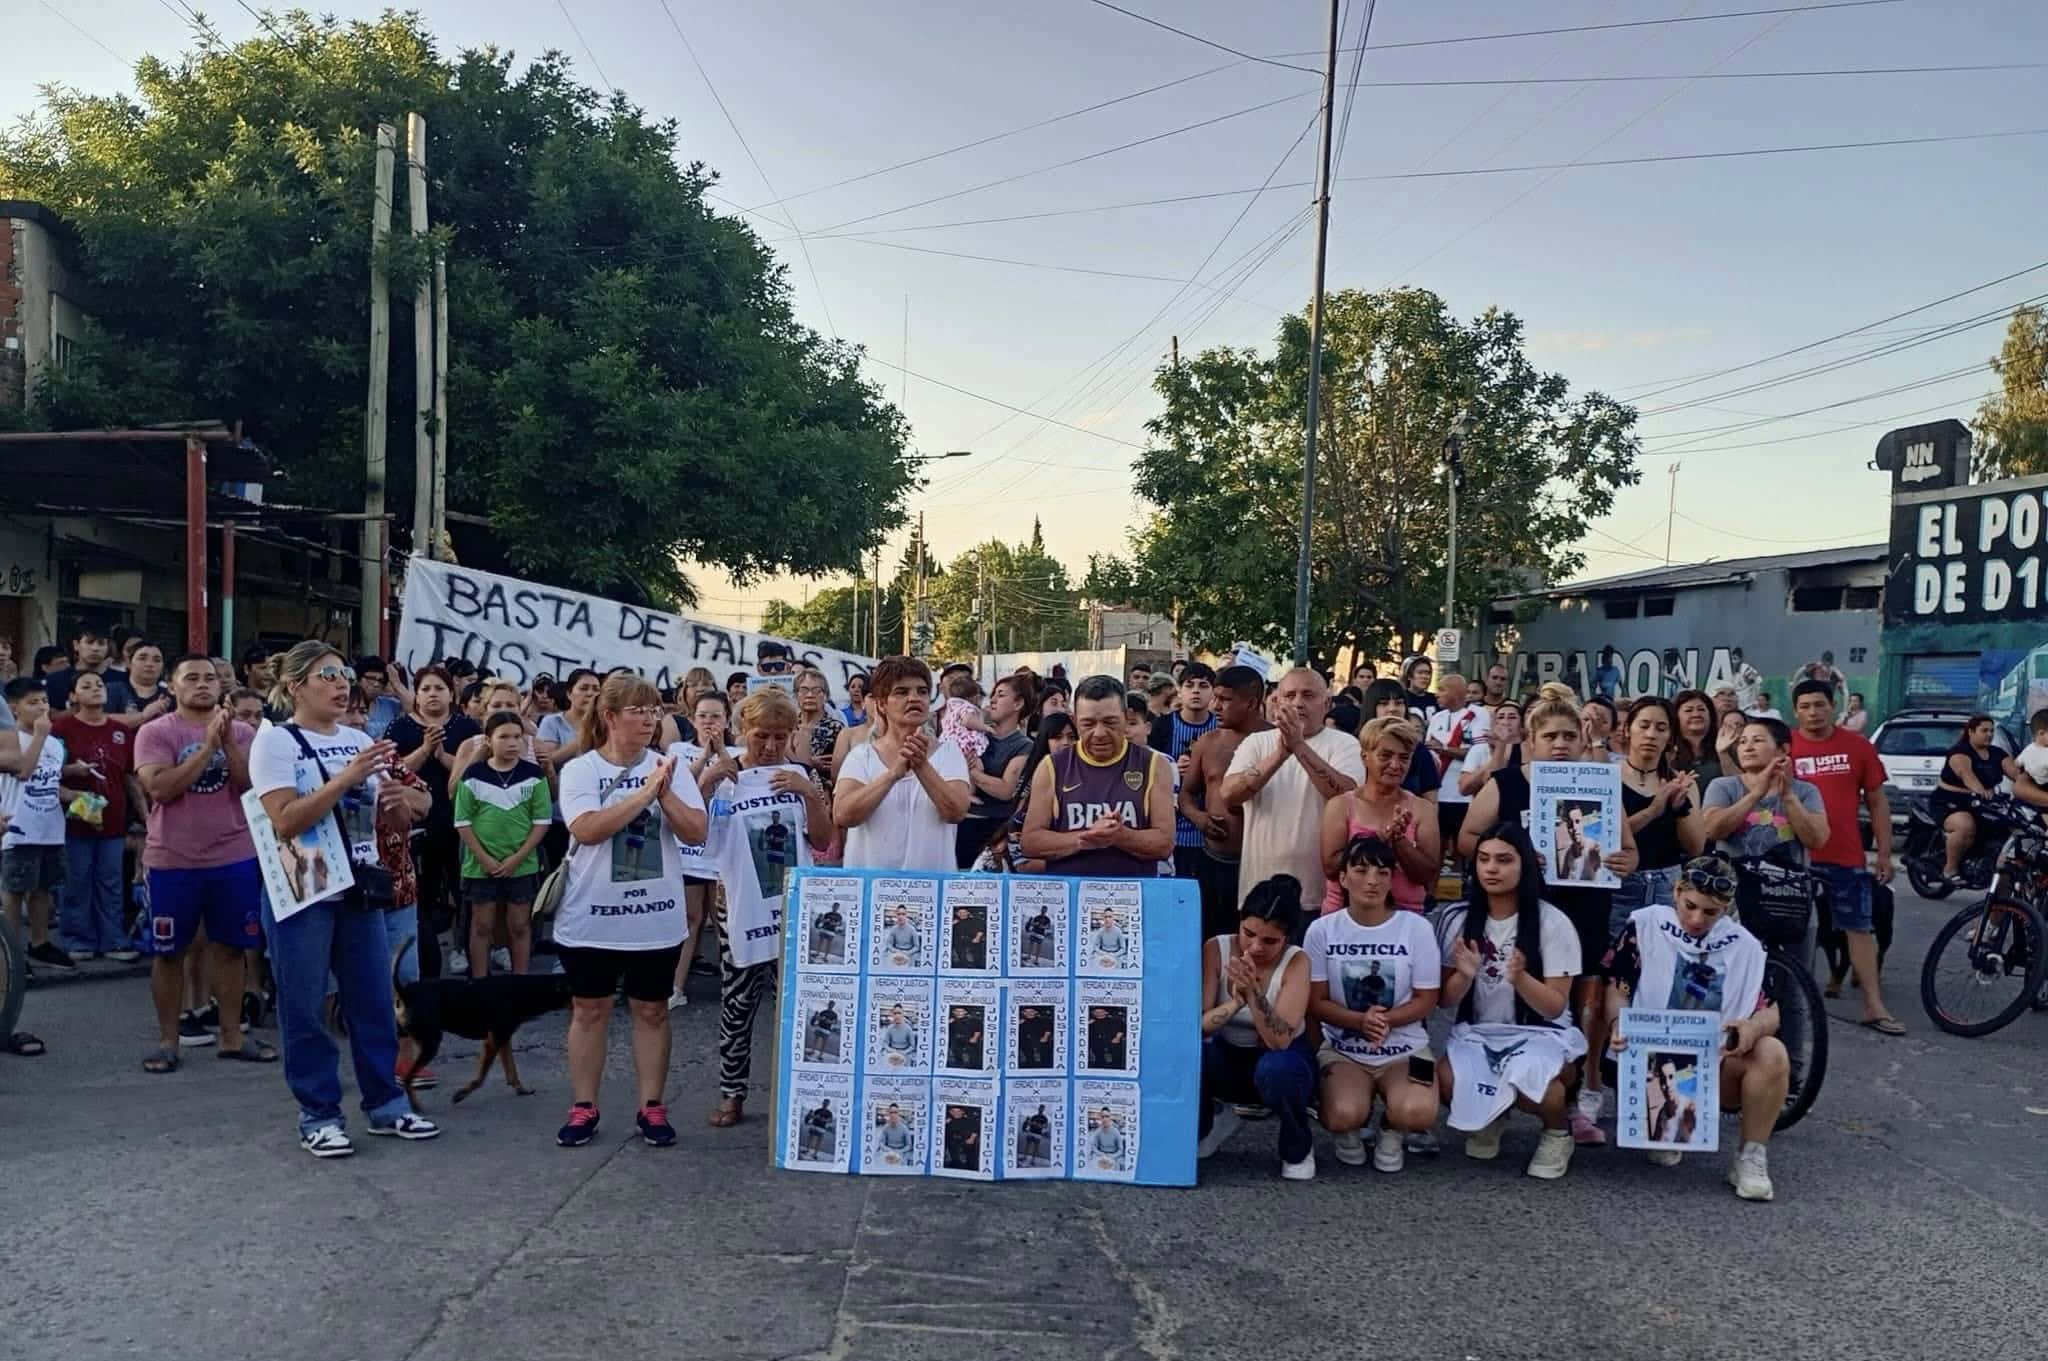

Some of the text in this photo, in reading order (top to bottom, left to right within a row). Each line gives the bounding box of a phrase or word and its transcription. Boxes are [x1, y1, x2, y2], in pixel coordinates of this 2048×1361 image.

[1917, 503, 1963, 558] EL
[446, 572, 594, 639] BASTA
[618, 605, 670, 651] DE
[1914, 556, 2048, 615] DE D1
[1536, 785, 1613, 796] FERNANDO MANSILLA
[1539, 766, 1568, 775] VERDAD
[1578, 767, 1610, 776] JUSTICIA
[1815, 754, 1848, 766] USITT
[1067, 801, 1138, 830] BBVA
[590, 899, 676, 917] FERNANDO
[624, 888, 648, 899] POR
[744, 922, 781, 941] FERN
[800, 904, 809, 964] VERDAD
[848, 904, 858, 964] JUSTICIA
[873, 904, 881, 965] VERDAD
[923, 906, 934, 967] JUSTICIA
[942, 906, 951, 968] VERDAD
[988, 908, 1000, 970] JUSTICIA
[1012, 906, 1020, 967] VERDAD
[1056, 908, 1066, 967] JUSTICIA
[1080, 906, 1088, 967] VERDAD
[1129, 908, 1140, 968] JUSTICIA
[1326, 943, 1408, 956] JUSTICIA
[794, 1000, 804, 1061] VERDAD
[842, 1004, 854, 1064] JUSTICIA
[868, 1002, 878, 1064] VERDAD
[919, 1005, 930, 1066] JUSTICIA
[938, 1006, 946, 1068] VERDAD
[986, 1007, 998, 1070] JUSTICIA
[1009, 1006, 1017, 1069] VERDAD
[1056, 1007, 1066, 1069] JUSTICIA
[1129, 1008, 1140, 1071] JUSTICIA
[1628, 1014, 1707, 1025] VERDAD Y JUSTICIA
[1671, 1038, 1710, 1048] MANSILLA
[1629, 1049, 1638, 1137] VERDAD
[838, 1102, 850, 1162] JUSTICIA
[864, 1102, 874, 1164] VERDAD
[915, 1104, 926, 1166] JUSTICIA
[934, 1104, 944, 1168] VERDAD
[982, 1110, 994, 1174] JUSTICIA
[1008, 1105, 1016, 1168] VERDAD
[1053, 1106, 1064, 1168] JUSTICIA
[1078, 1105, 1086, 1168] VERDAD
